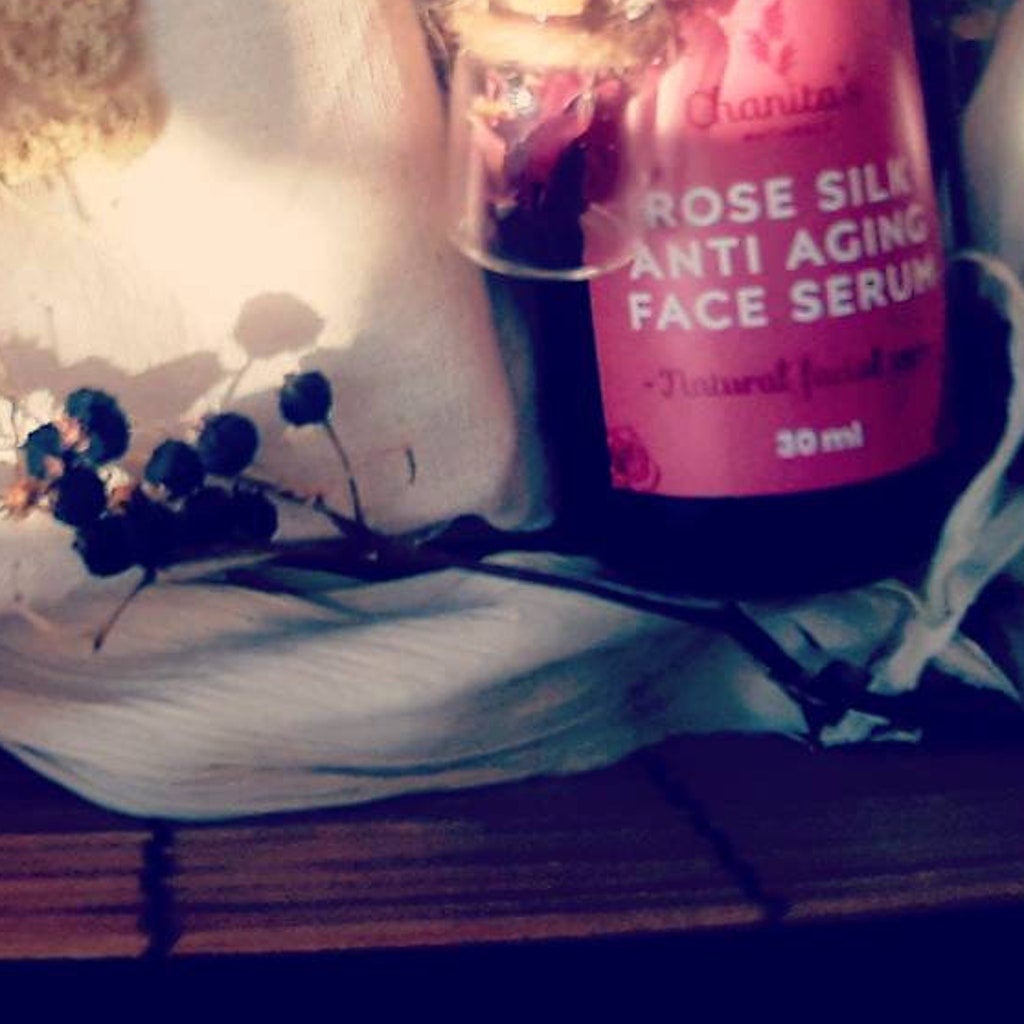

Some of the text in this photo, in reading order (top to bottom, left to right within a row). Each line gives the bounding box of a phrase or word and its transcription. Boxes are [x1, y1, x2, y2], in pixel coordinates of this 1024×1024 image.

[643, 154, 914, 228] ROSE SILK
[629, 203, 928, 281] ANTI AGING
[628, 254, 938, 330] FACE SERUM
[776, 420, 864, 458] 30 ml
